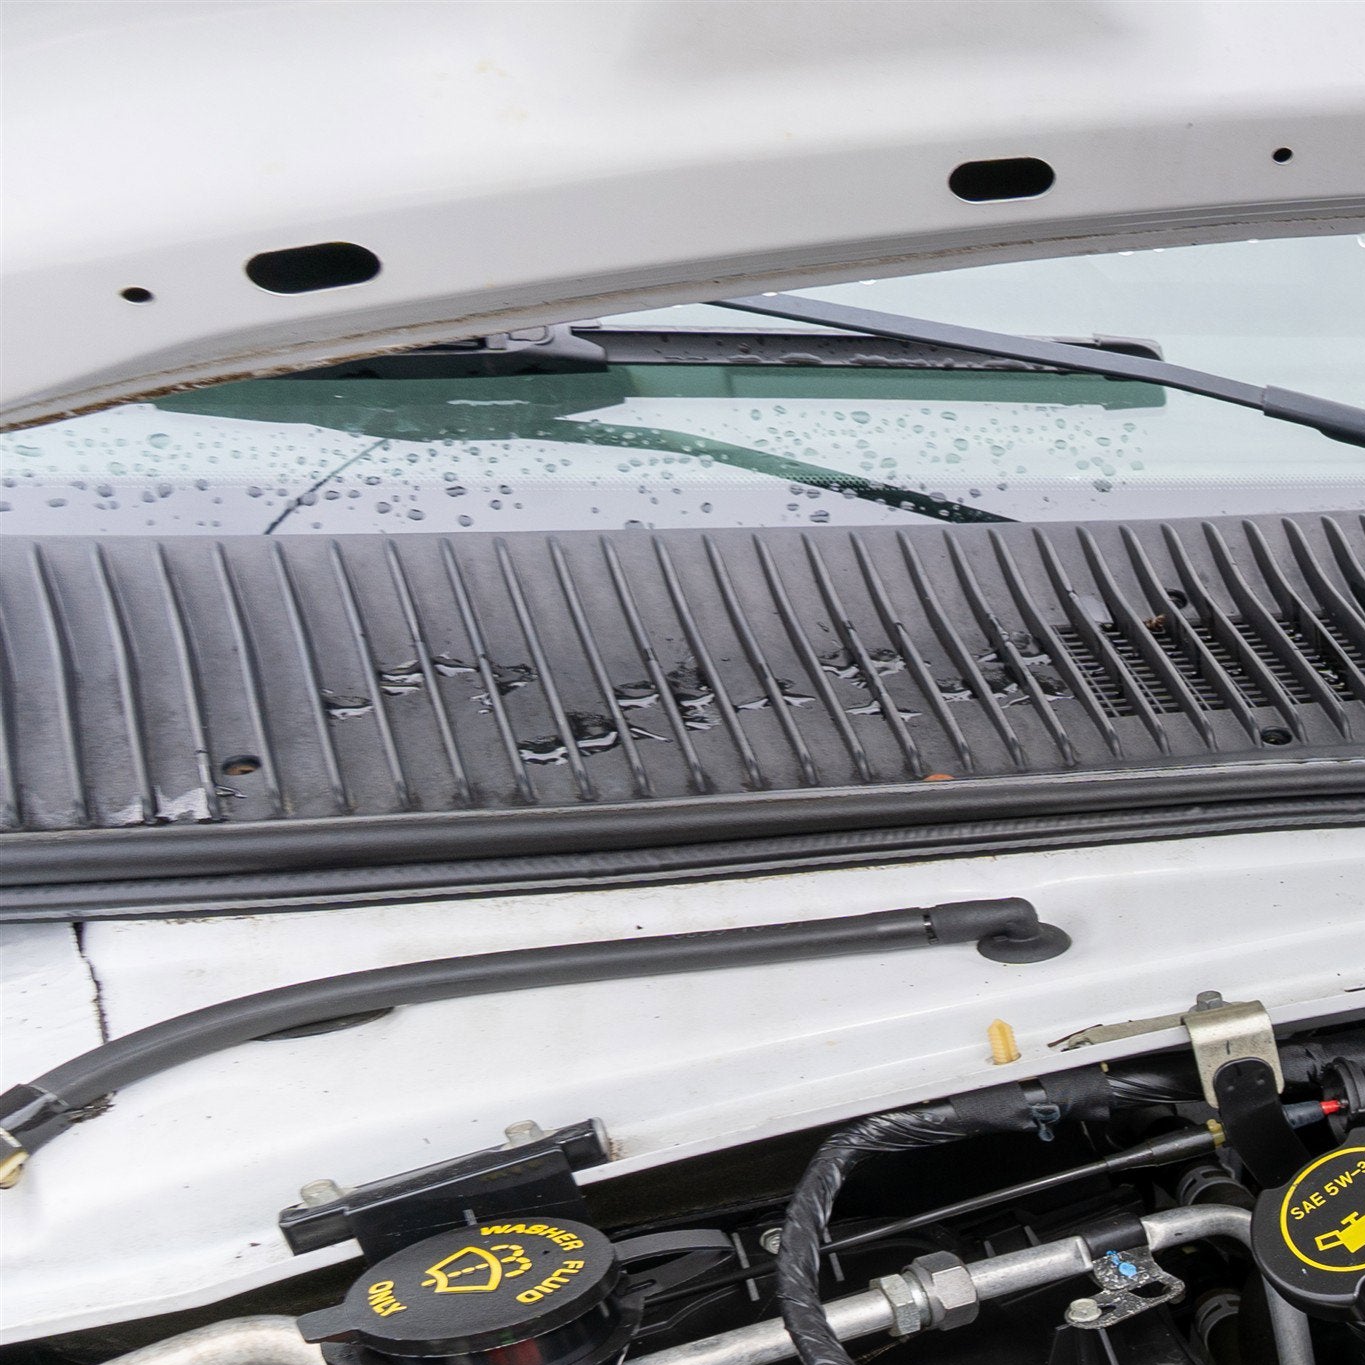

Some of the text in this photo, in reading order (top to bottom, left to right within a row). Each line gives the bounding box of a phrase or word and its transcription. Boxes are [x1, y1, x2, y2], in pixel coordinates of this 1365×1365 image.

[1290, 1191, 1326, 1220] SAE
[368, 1222, 585, 1317] WASHER FLUID ONLY
